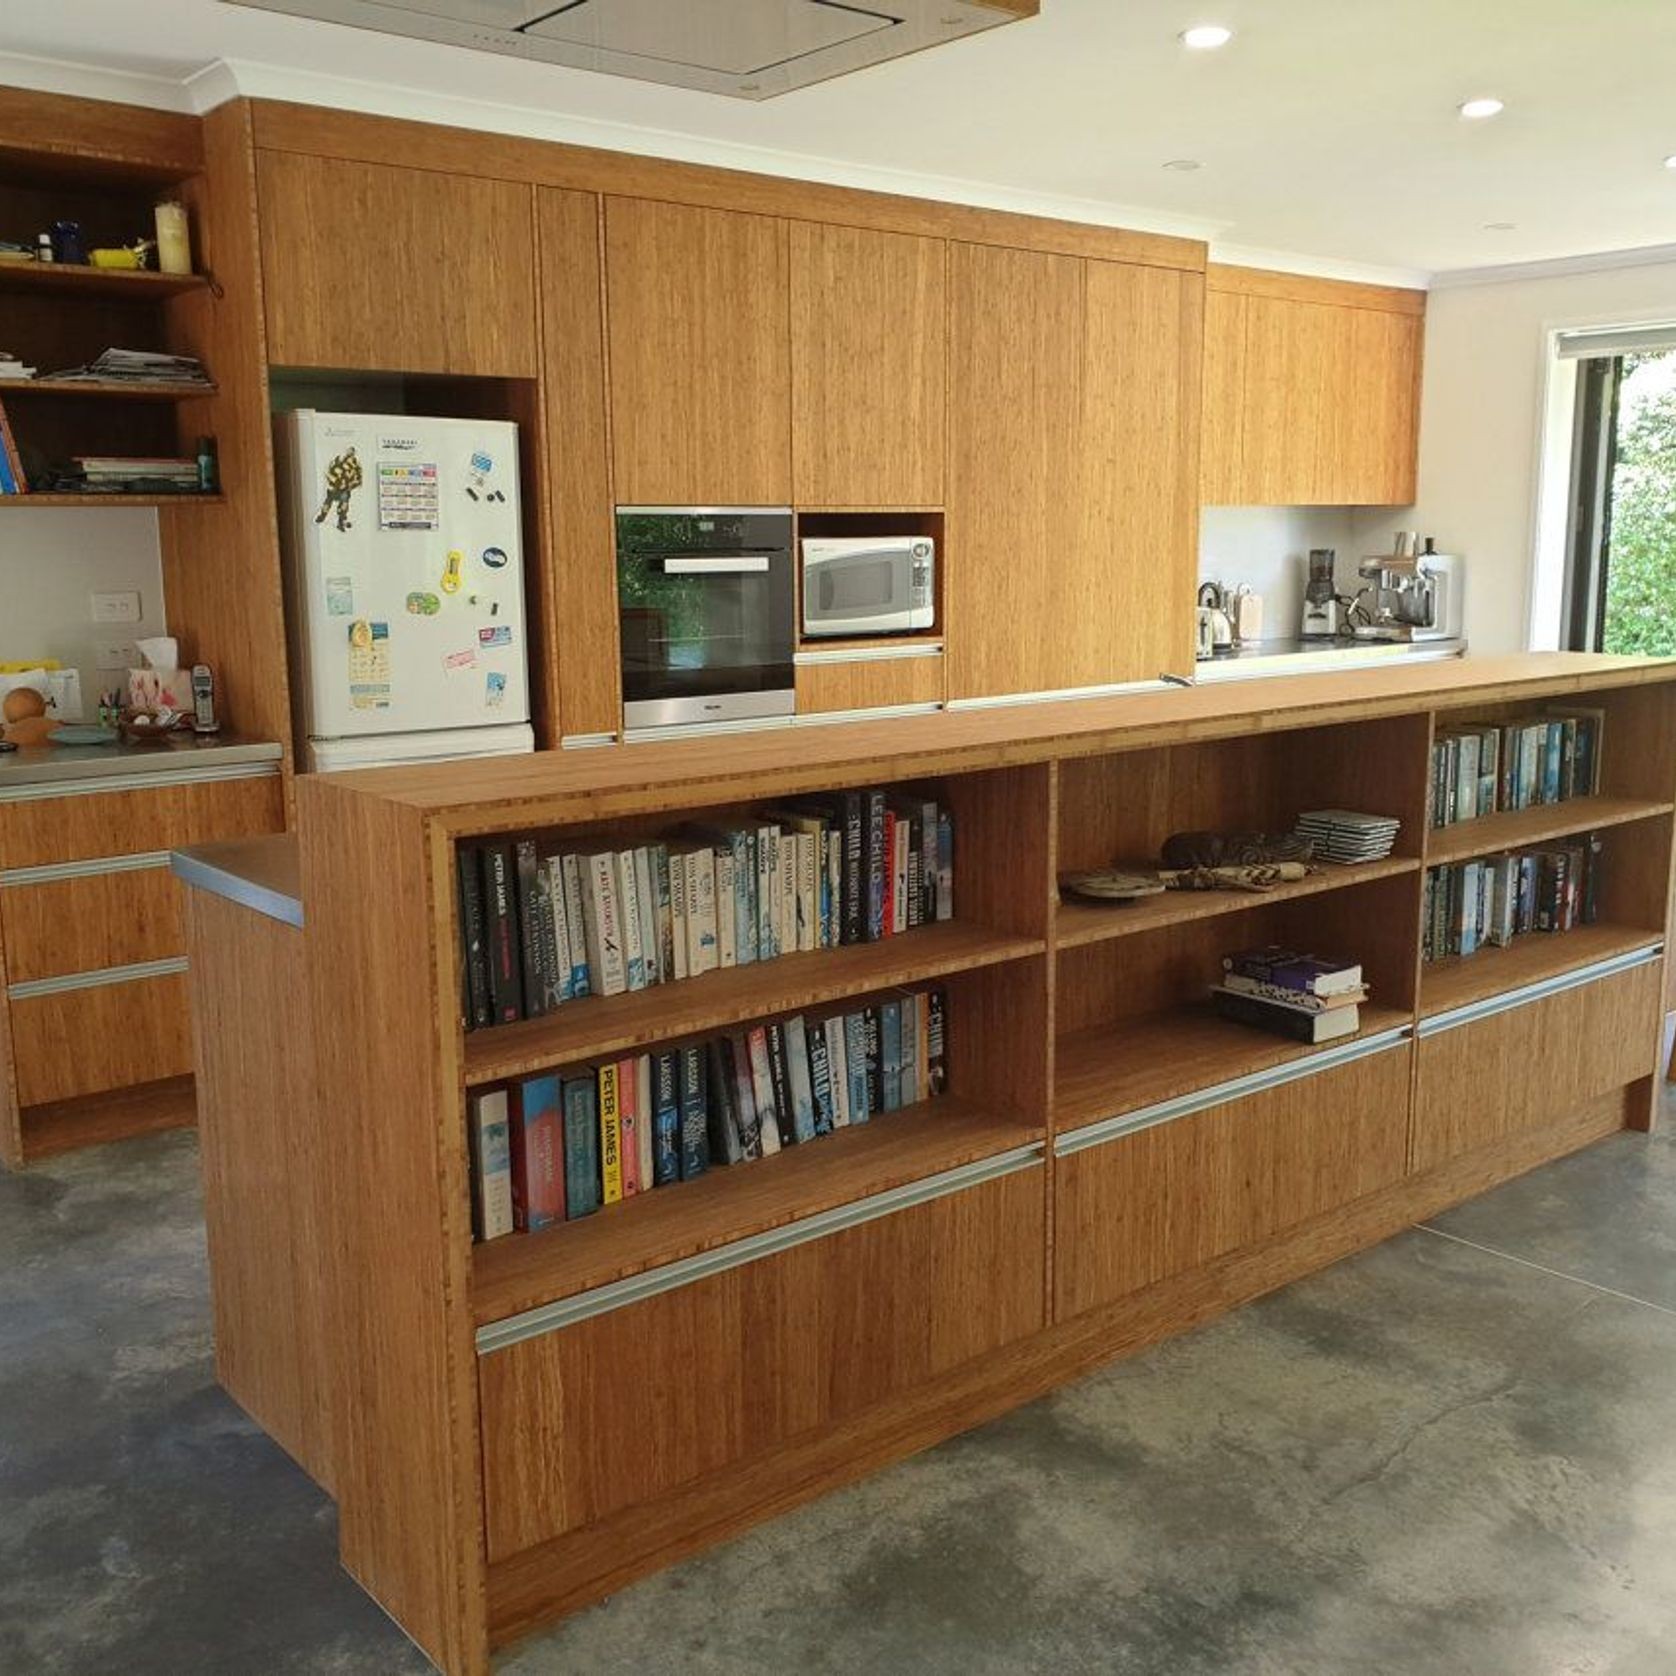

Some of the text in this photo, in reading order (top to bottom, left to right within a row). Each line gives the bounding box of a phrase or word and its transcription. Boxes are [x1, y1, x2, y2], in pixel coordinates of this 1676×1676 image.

[848, 819, 861, 858] CHILD
[870, 794, 882, 884] LEE CHILD
[494, 853, 504, 883] PETER
[496, 884, 507, 914] JAMES
[602, 1069, 614, 1115] PETER
[658, 1055, 672, 1101] LARSSON
[686, 1048, 698, 1093] LARSSON
[811, 1046, 829, 1096] CHILD
[604, 1118, 616, 1165] JAMES
